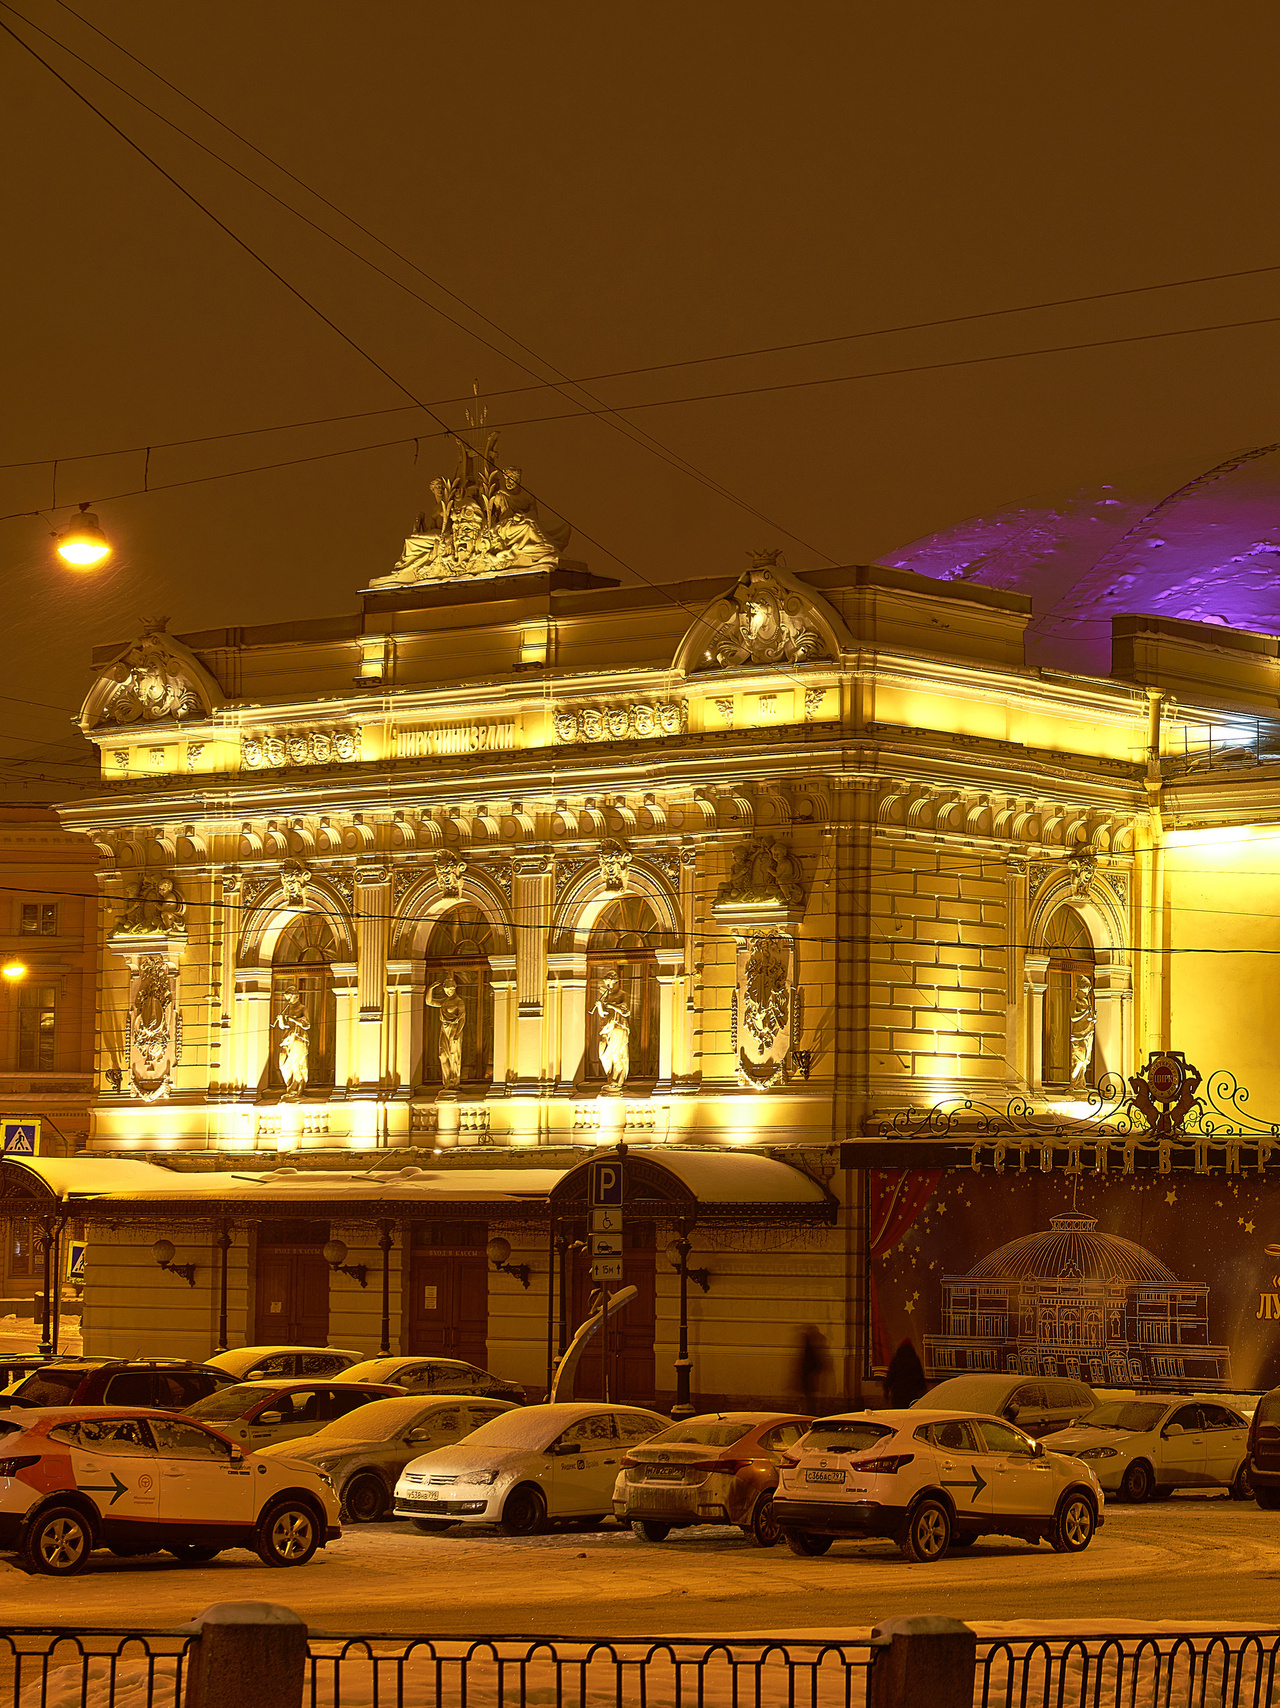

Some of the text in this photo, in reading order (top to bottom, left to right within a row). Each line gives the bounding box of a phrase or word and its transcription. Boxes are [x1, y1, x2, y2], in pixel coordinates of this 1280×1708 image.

[397, 723, 515, 758] ЦИРК ЧИНИЗЕЛЛИ
[600, 1168, 616, 1201] P
